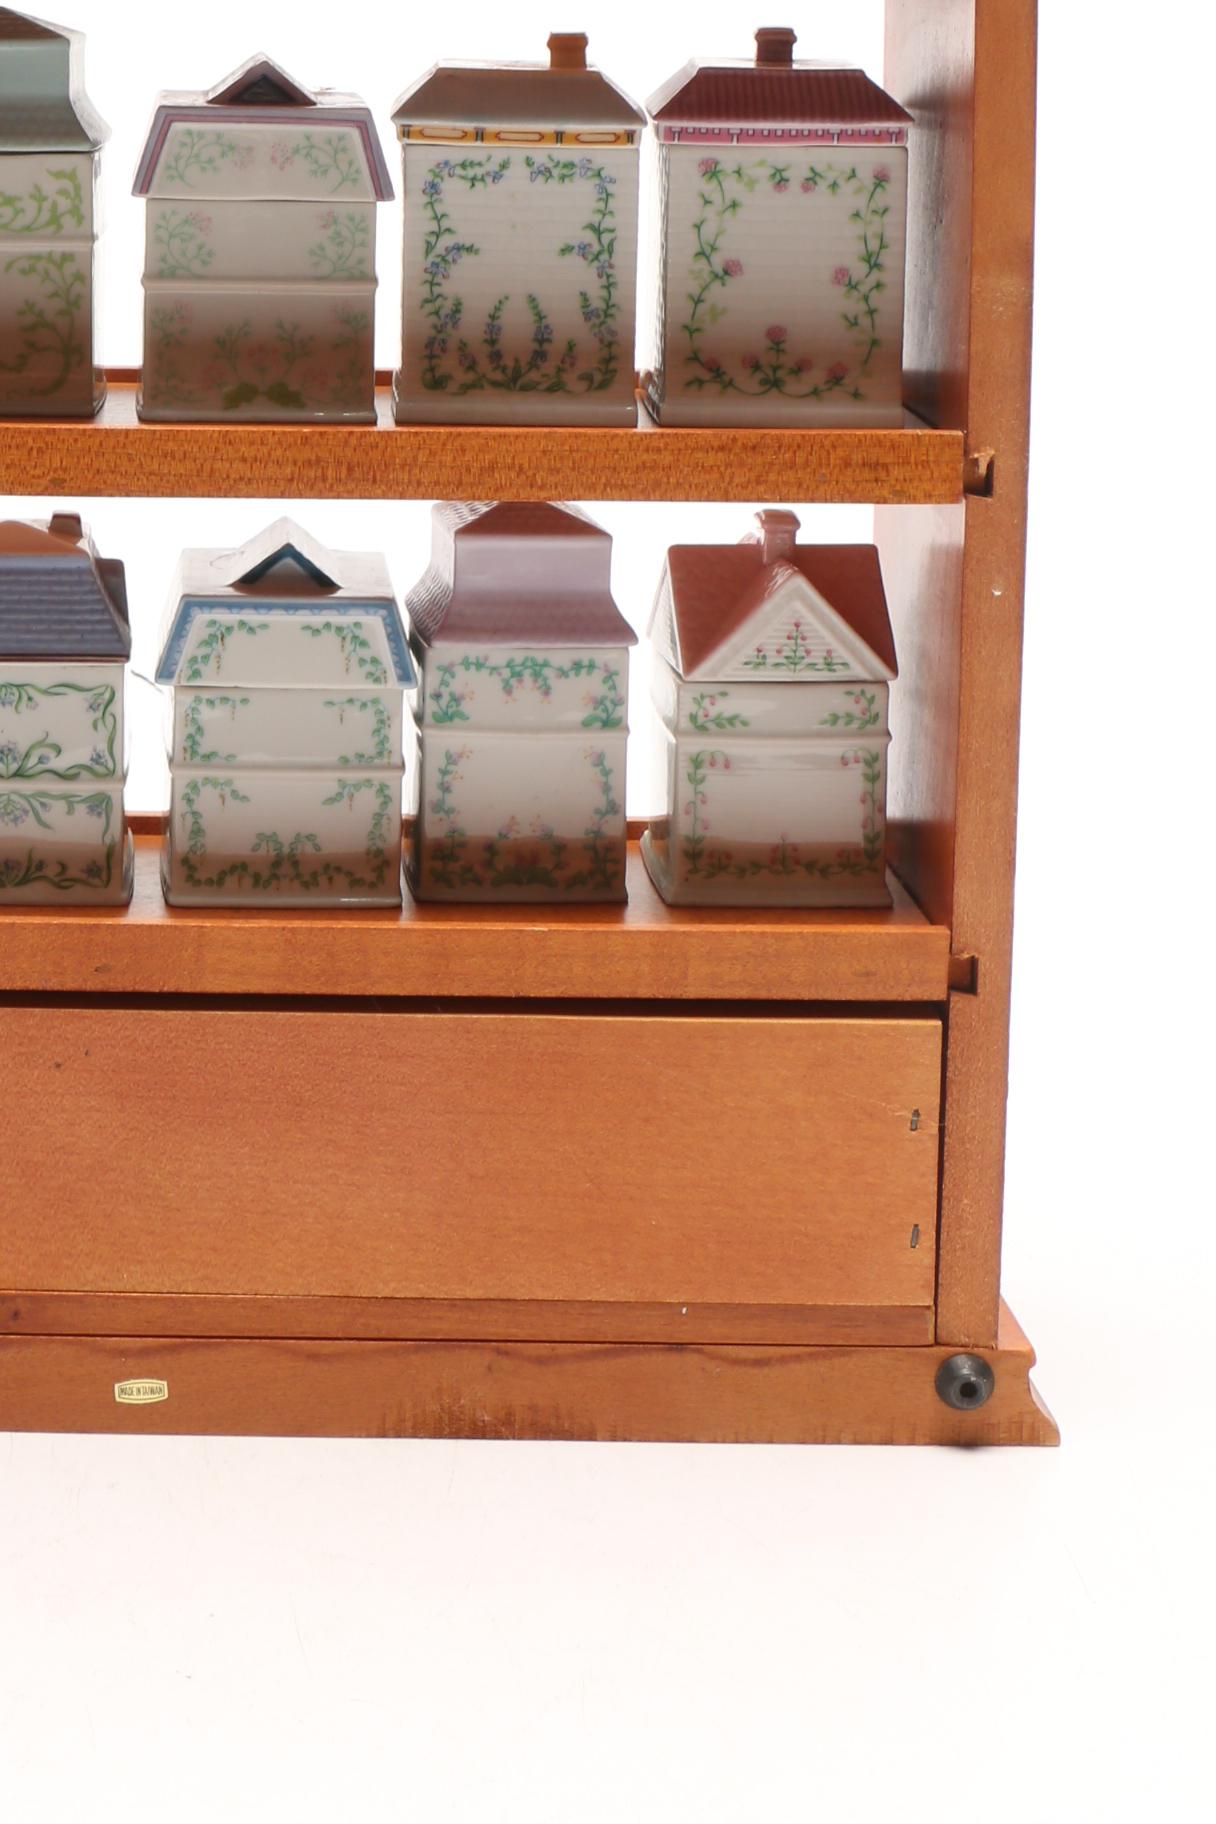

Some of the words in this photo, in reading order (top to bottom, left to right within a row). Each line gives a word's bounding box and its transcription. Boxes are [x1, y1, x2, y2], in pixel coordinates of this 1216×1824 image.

[120, 1387, 135, 1396] MADE
[136, 1387, 141, 1396] IN
[142, 1386, 163, 1396] TAIWAN
